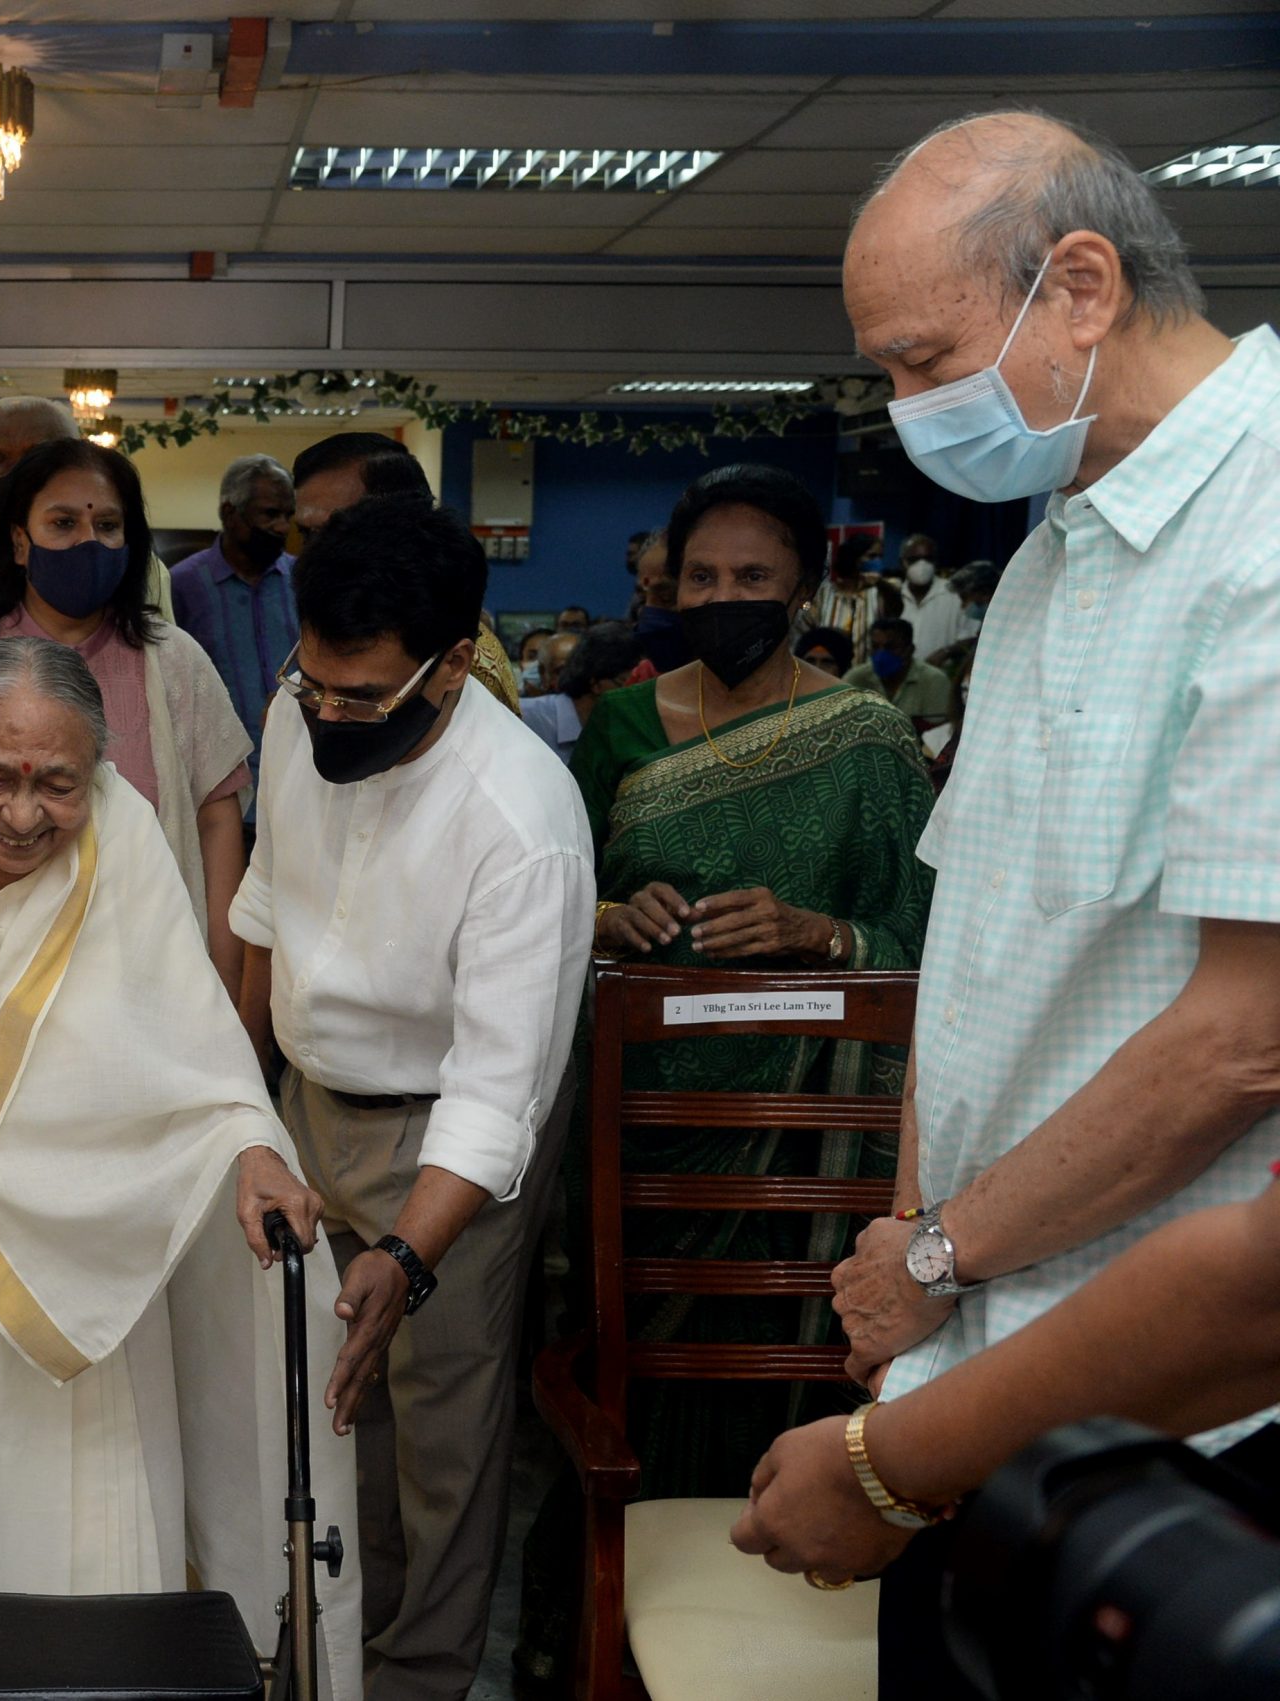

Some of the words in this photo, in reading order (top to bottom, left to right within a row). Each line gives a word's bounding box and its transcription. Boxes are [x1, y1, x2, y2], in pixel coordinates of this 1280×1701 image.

[675, 1006, 681, 1014] 2
[703, 1003, 726, 1013] YBhg
[728, 1003, 746, 1011] Tan
[748, 1002, 761, 1011] Sri
[764, 1002, 781, 1010] Lee
[783, 1002, 804, 1010] Lam
[807, 1001, 832, 1012] Thye
